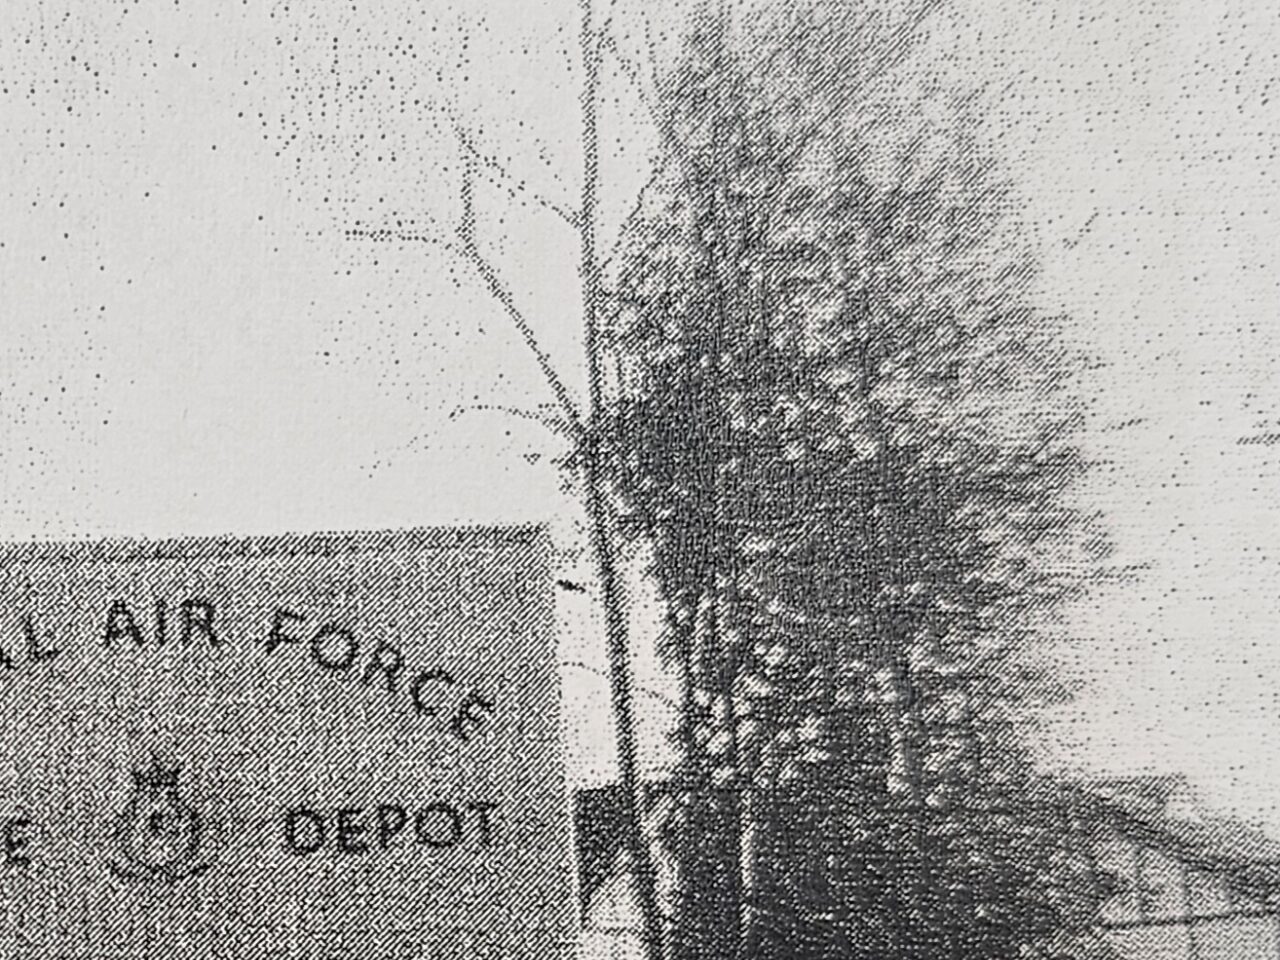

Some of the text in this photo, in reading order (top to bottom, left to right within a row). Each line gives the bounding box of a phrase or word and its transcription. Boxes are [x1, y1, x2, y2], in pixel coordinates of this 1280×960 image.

[103, 598, 222, 648] AIR
[263, 606, 498, 744] FORCE
[284, 802, 501, 856] DEPOT
